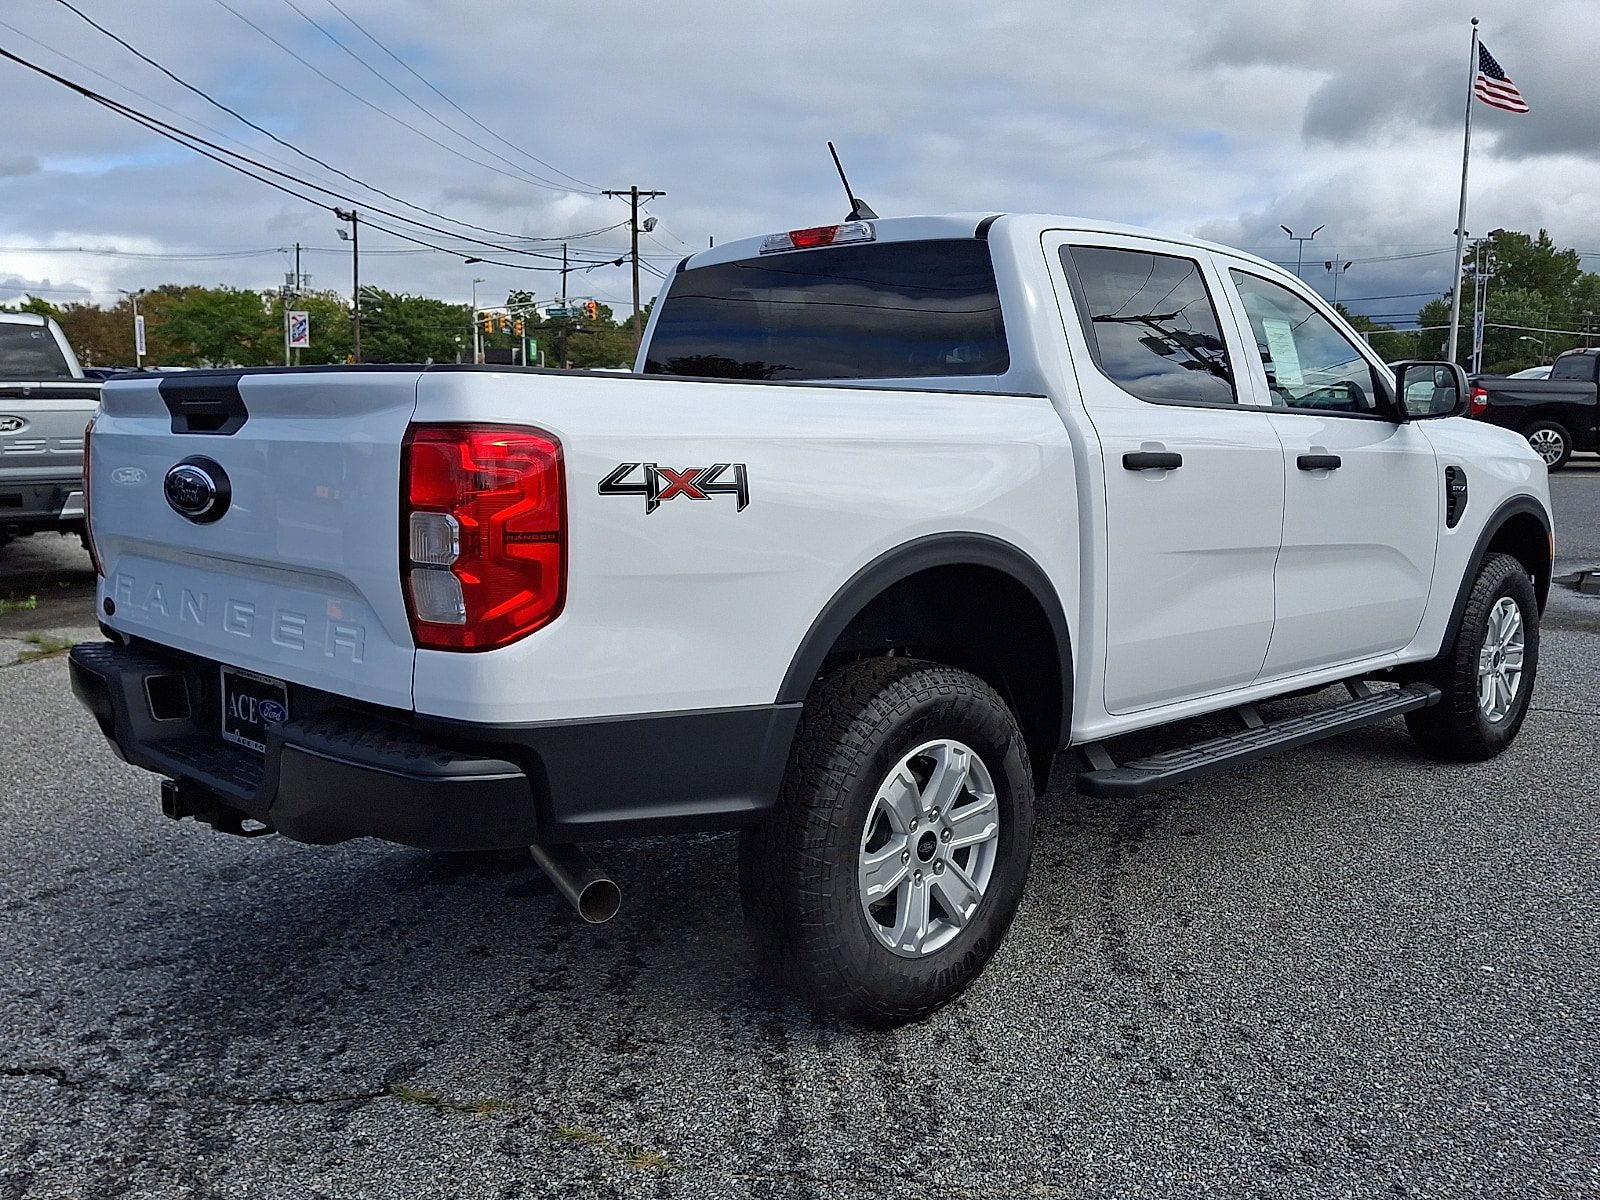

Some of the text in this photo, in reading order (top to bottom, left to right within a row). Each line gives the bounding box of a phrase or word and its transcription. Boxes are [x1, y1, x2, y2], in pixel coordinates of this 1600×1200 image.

[506, 533, 557, 541] RANGER
[115, 573, 366, 664] RANGER
[228, 691, 284, 724] ACE Ford
